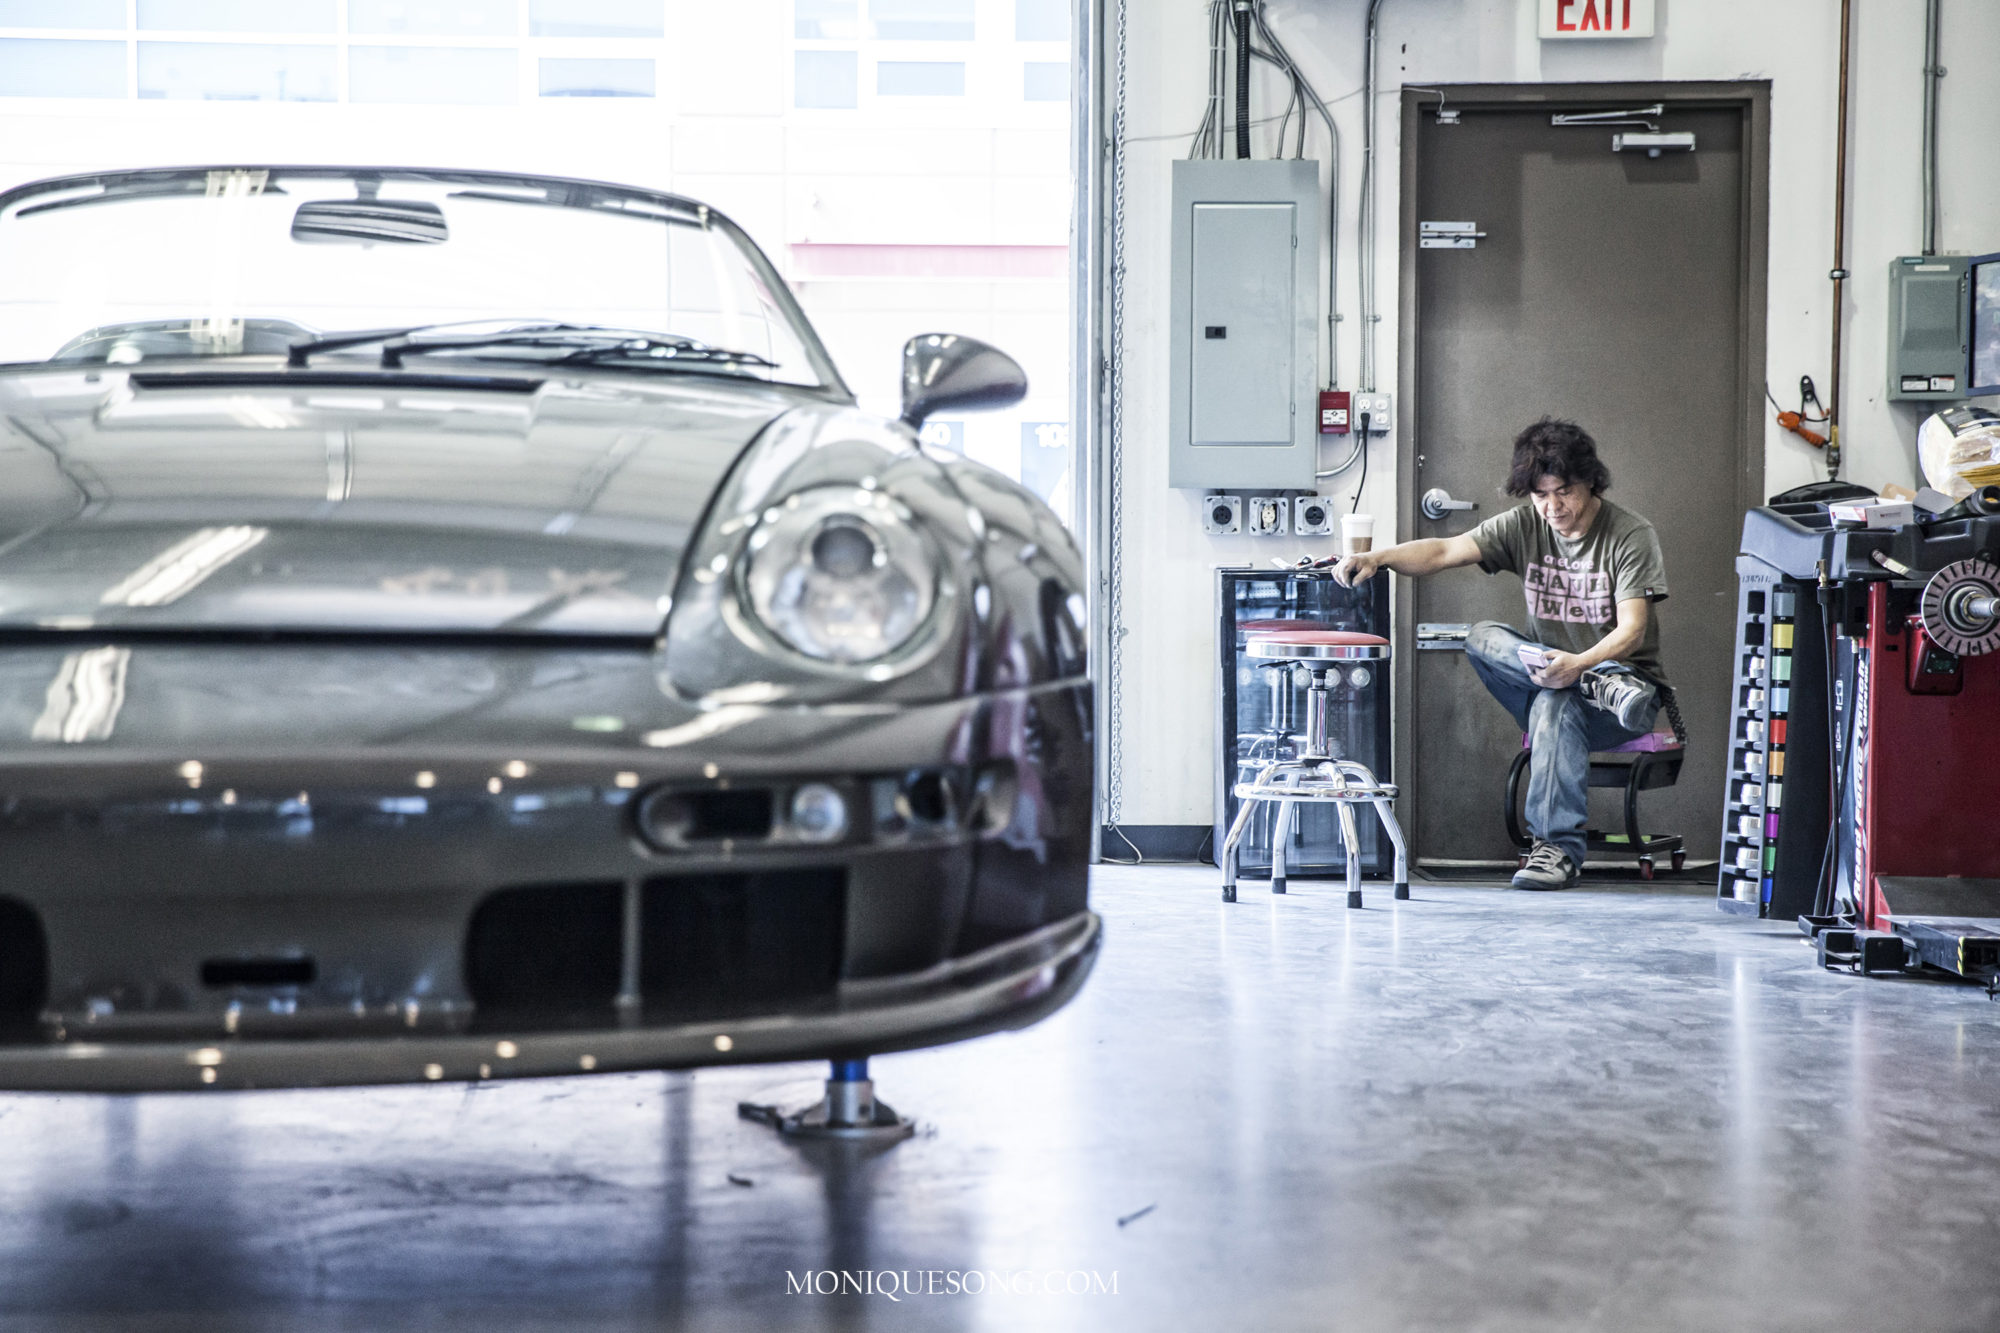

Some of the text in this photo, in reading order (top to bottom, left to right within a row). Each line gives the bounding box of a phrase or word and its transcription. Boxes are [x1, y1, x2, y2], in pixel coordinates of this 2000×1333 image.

[1557, 0, 1630, 31] EXIT
[1528, 568, 1607, 592] RAUH
[1855, 746, 1863, 827] Force
[1853, 827, 1862, 902] Road
